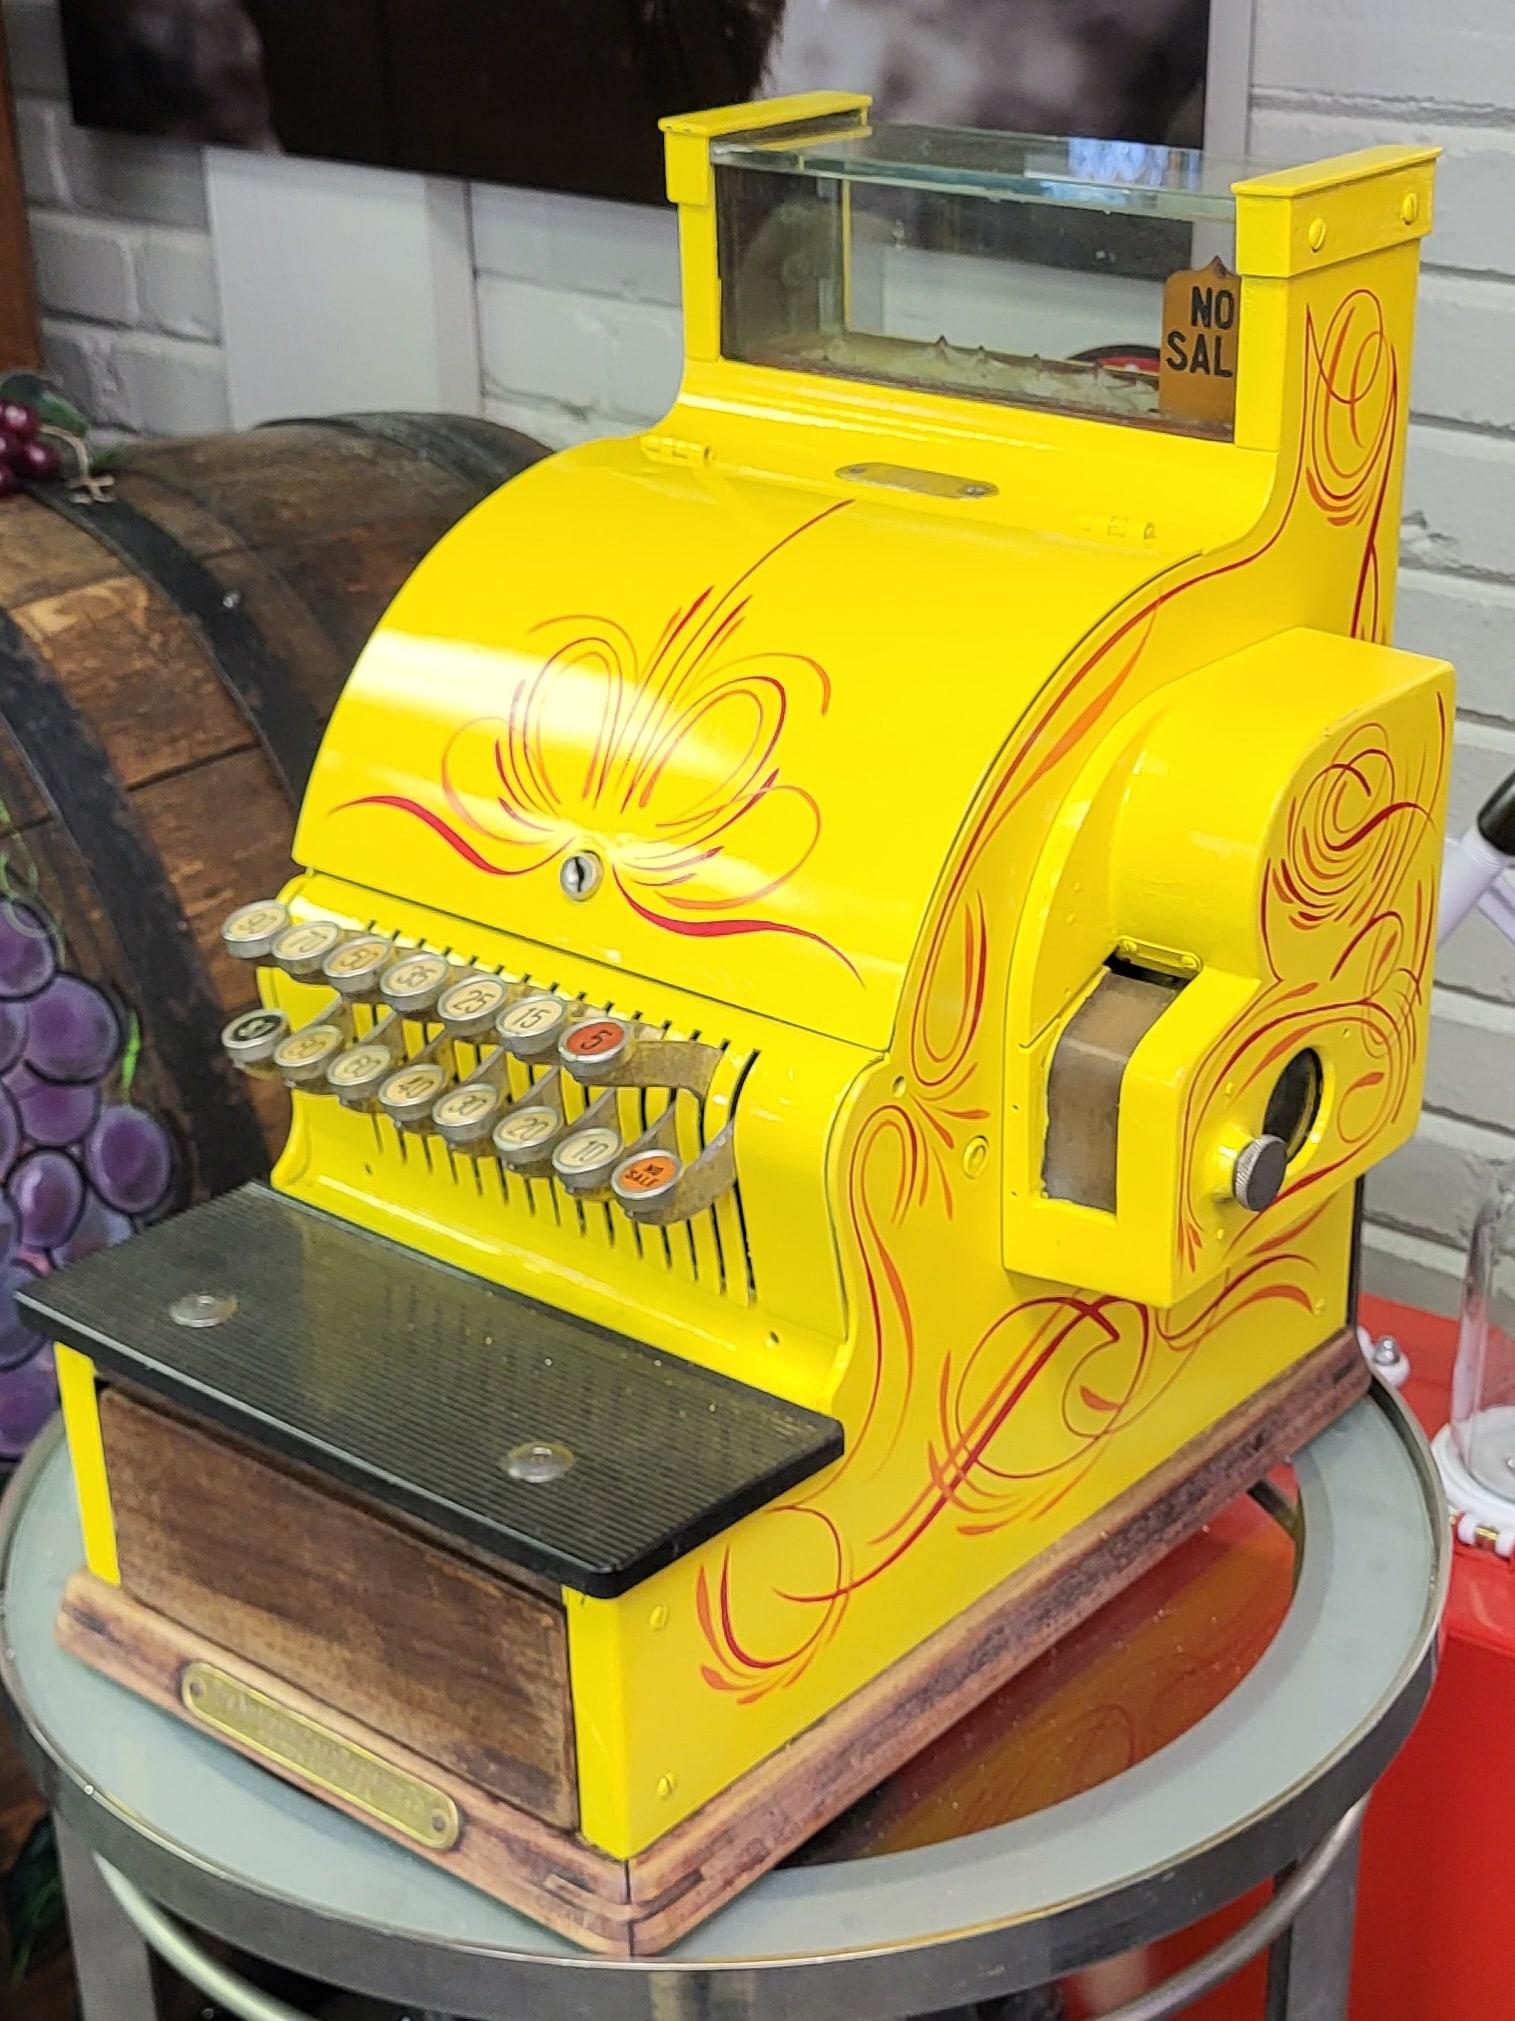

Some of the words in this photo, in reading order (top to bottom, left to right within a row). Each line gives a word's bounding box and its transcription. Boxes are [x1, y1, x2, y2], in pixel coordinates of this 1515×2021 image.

[1191, 286, 1235, 330] NO
[1165, 331, 1233, 378] SAL
[453, 990, 496, 1014] 25
[513, 1006, 551, 1029] 15
[580, 1029, 612, 1050] 5
[507, 1117, 549, 1142] 20
[572, 1140, 610, 1162] 10
